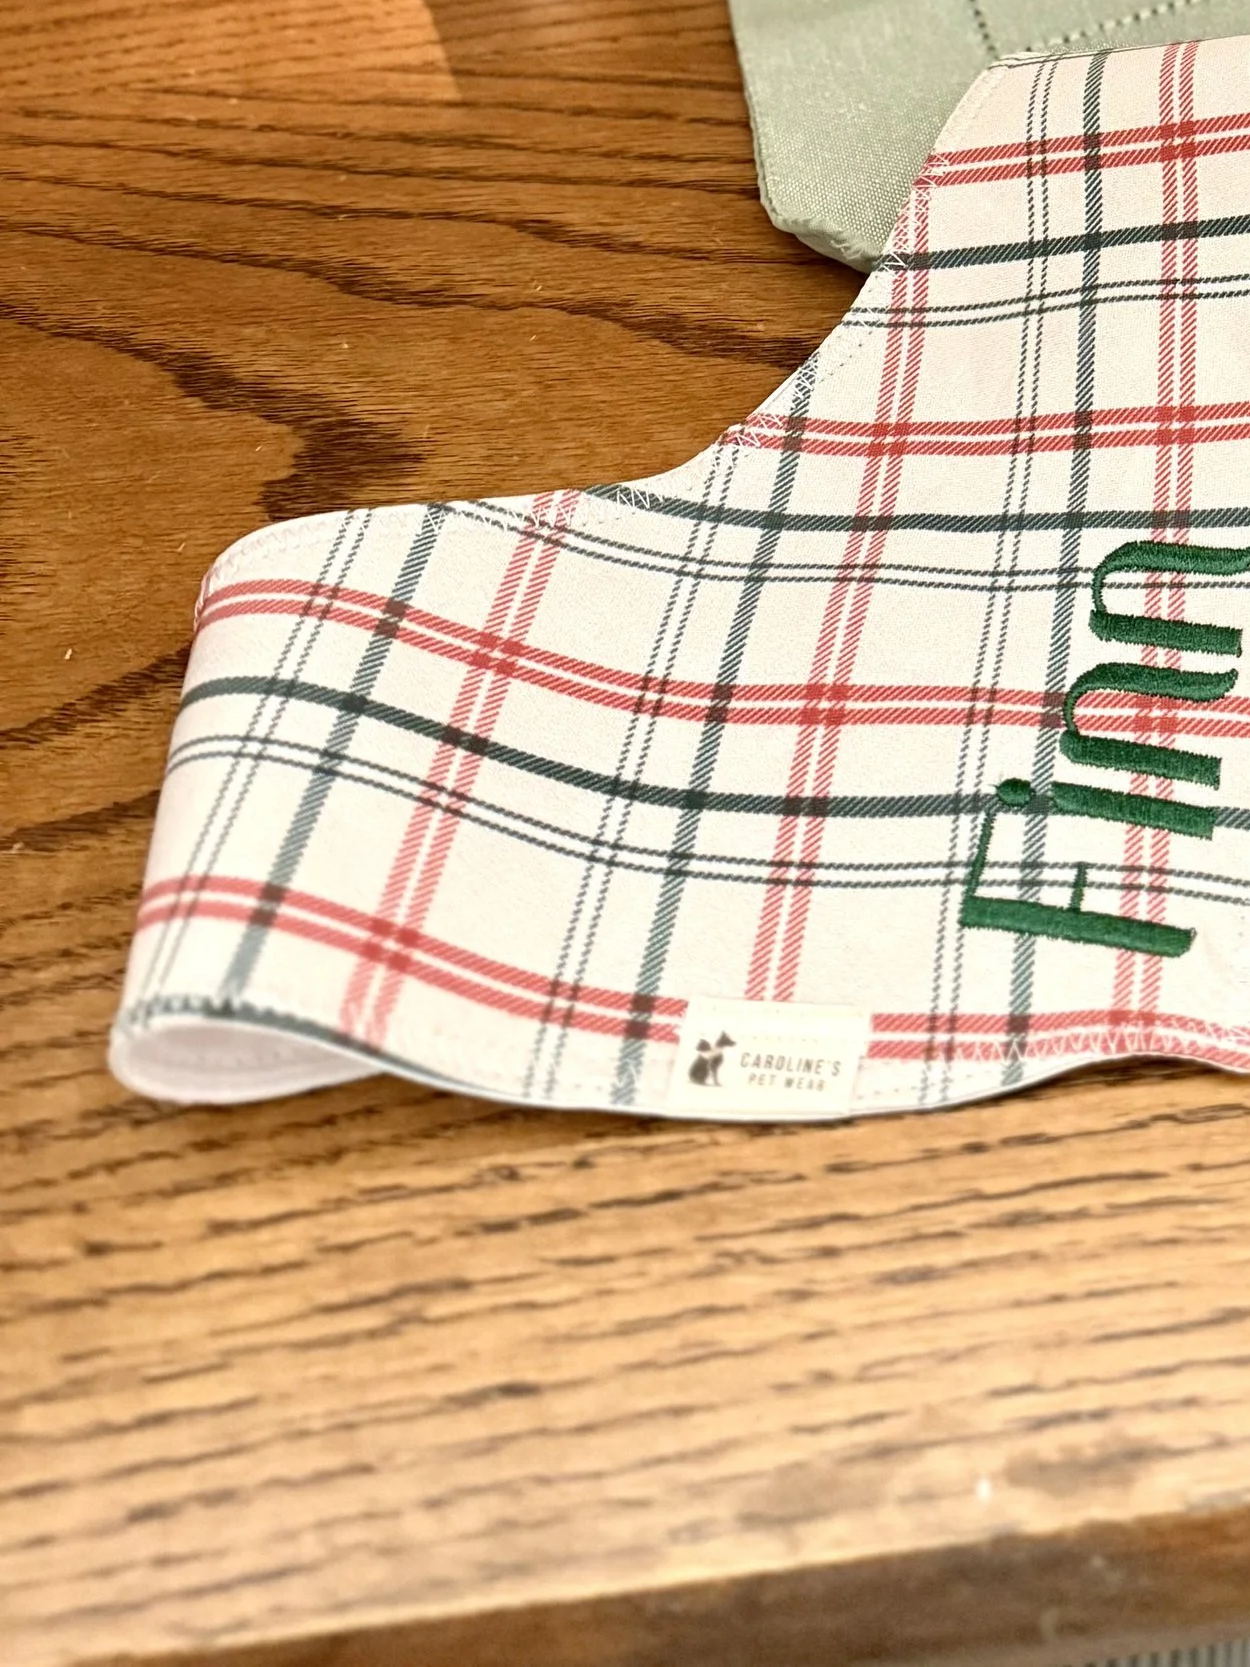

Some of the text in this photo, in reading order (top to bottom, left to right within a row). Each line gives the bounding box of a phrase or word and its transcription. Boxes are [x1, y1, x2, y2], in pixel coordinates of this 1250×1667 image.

[740, 1051, 842, 1078] CAROLINE'S
[748, 1072, 826, 1092] PET WEAR
